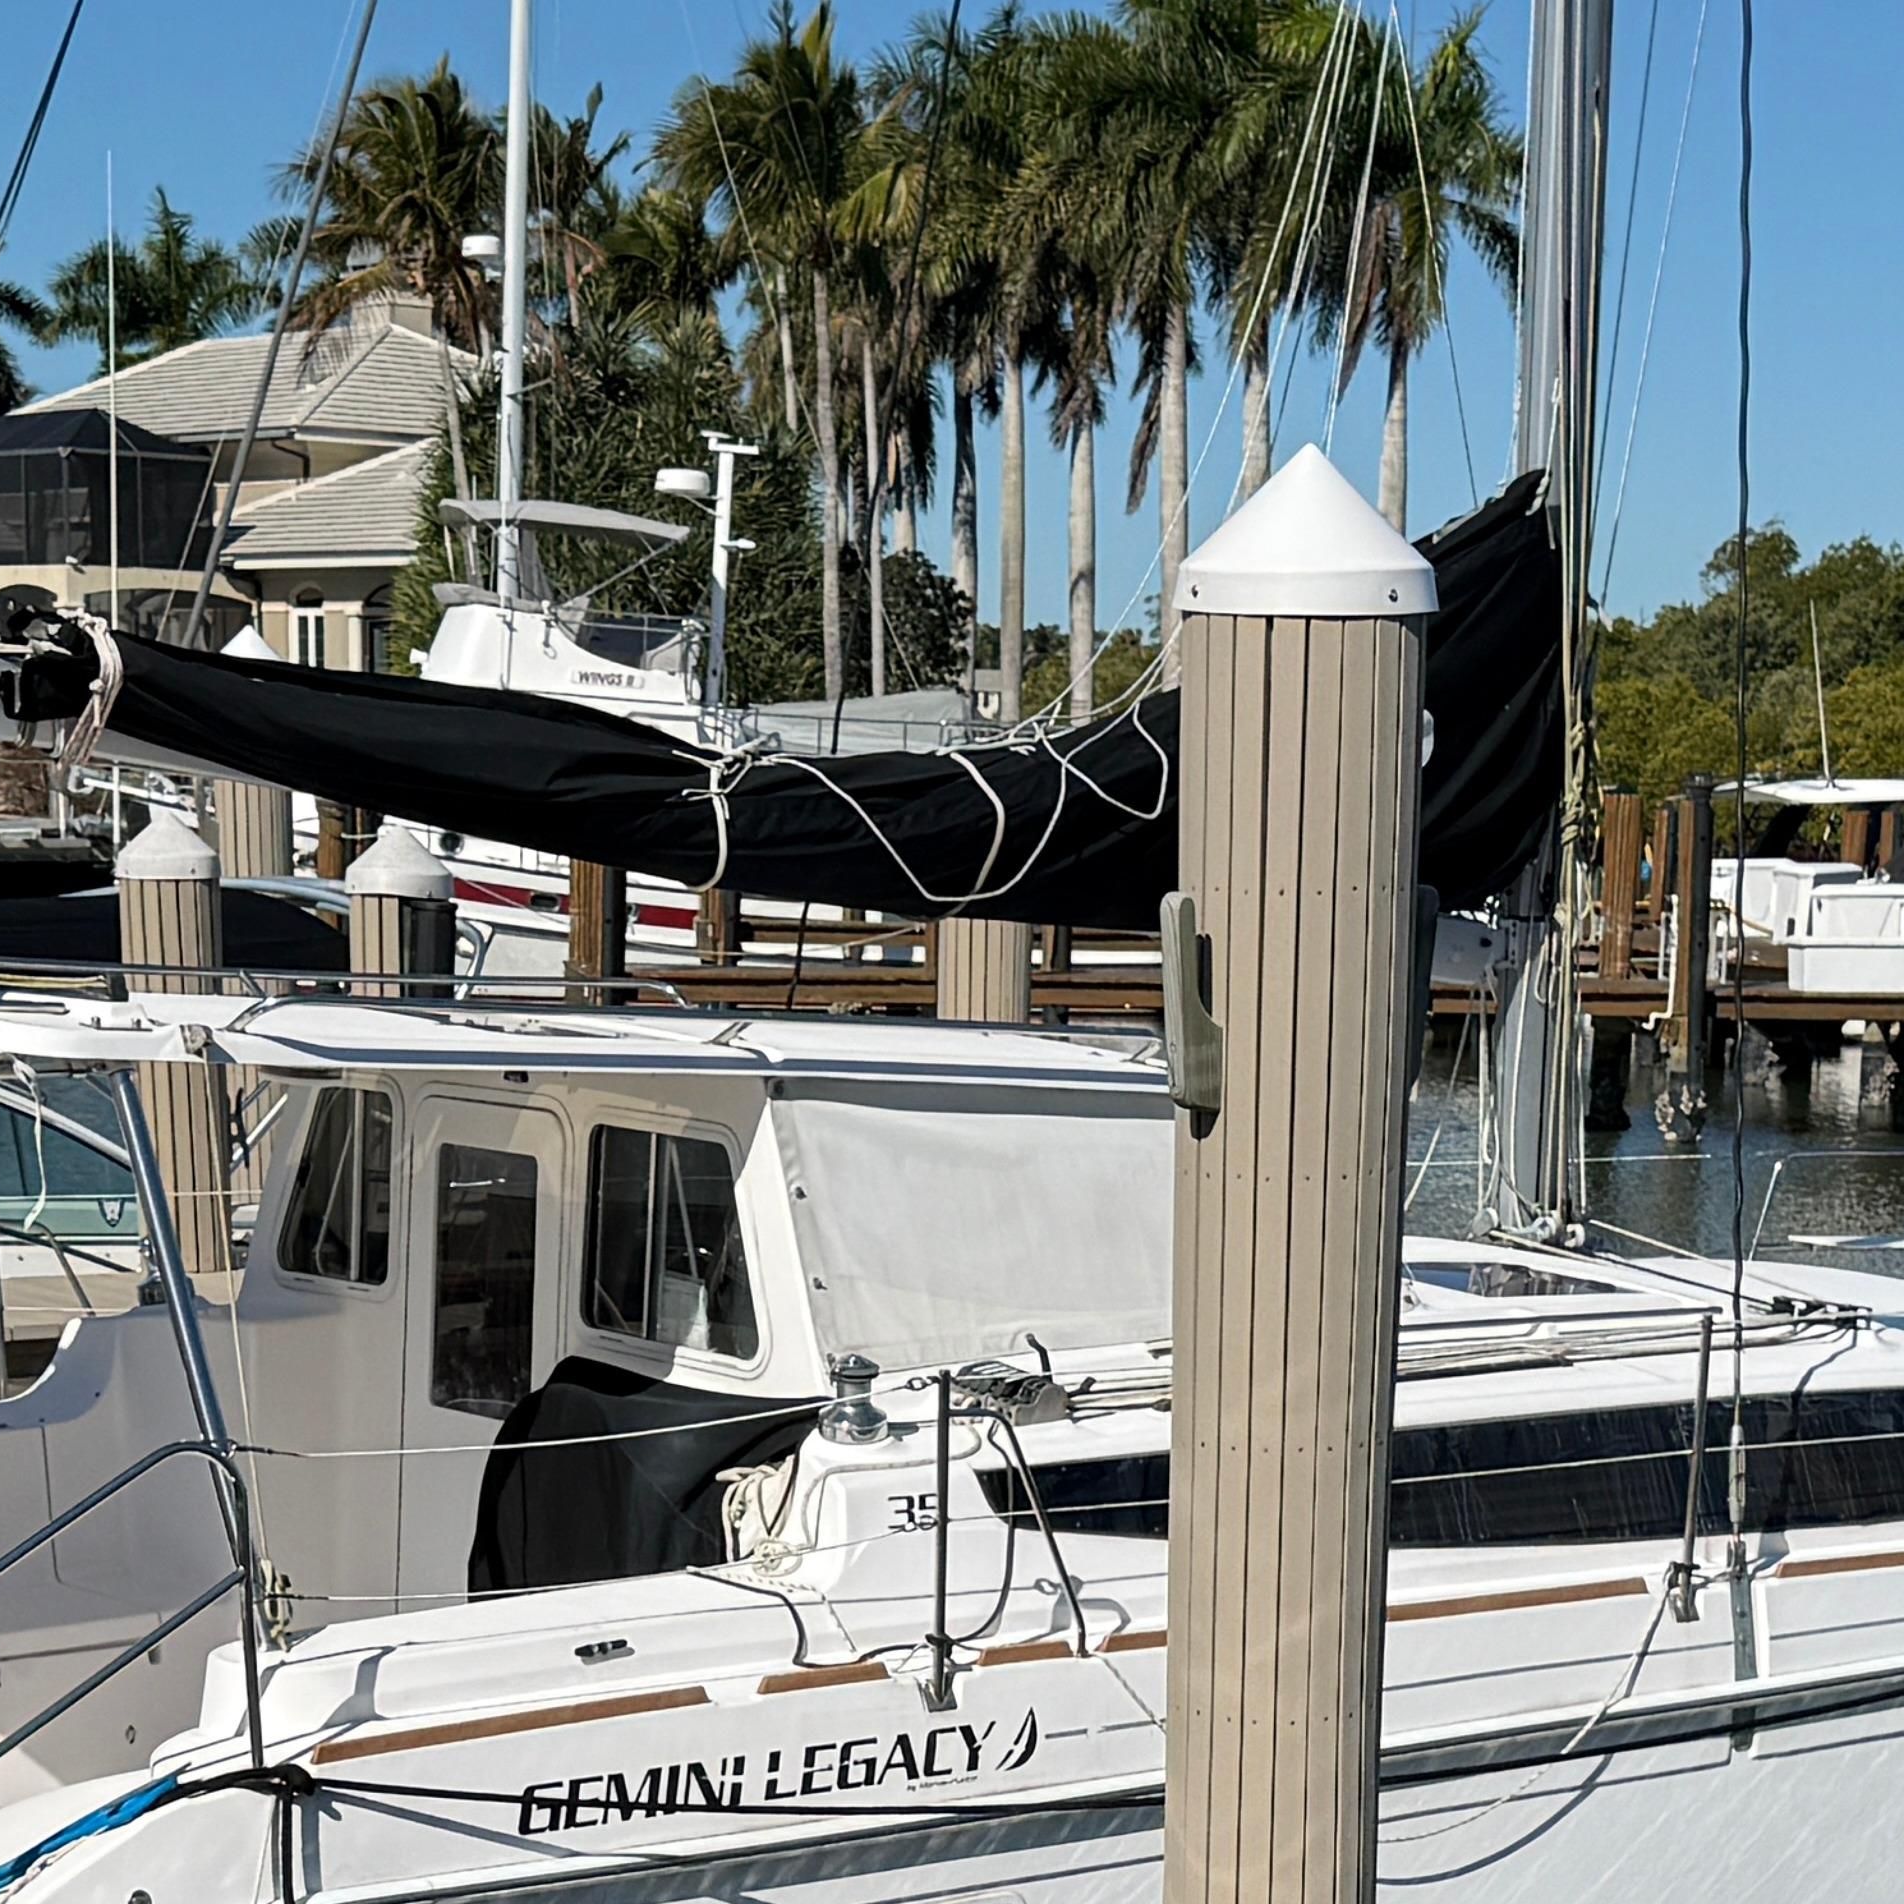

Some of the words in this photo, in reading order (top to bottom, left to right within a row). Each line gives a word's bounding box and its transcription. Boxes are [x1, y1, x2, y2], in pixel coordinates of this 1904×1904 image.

[578, 671, 623, 686] WINGS
[518, 1755, 746, 1835] GEMINI
[764, 1721, 997, 1801] LEGACY
